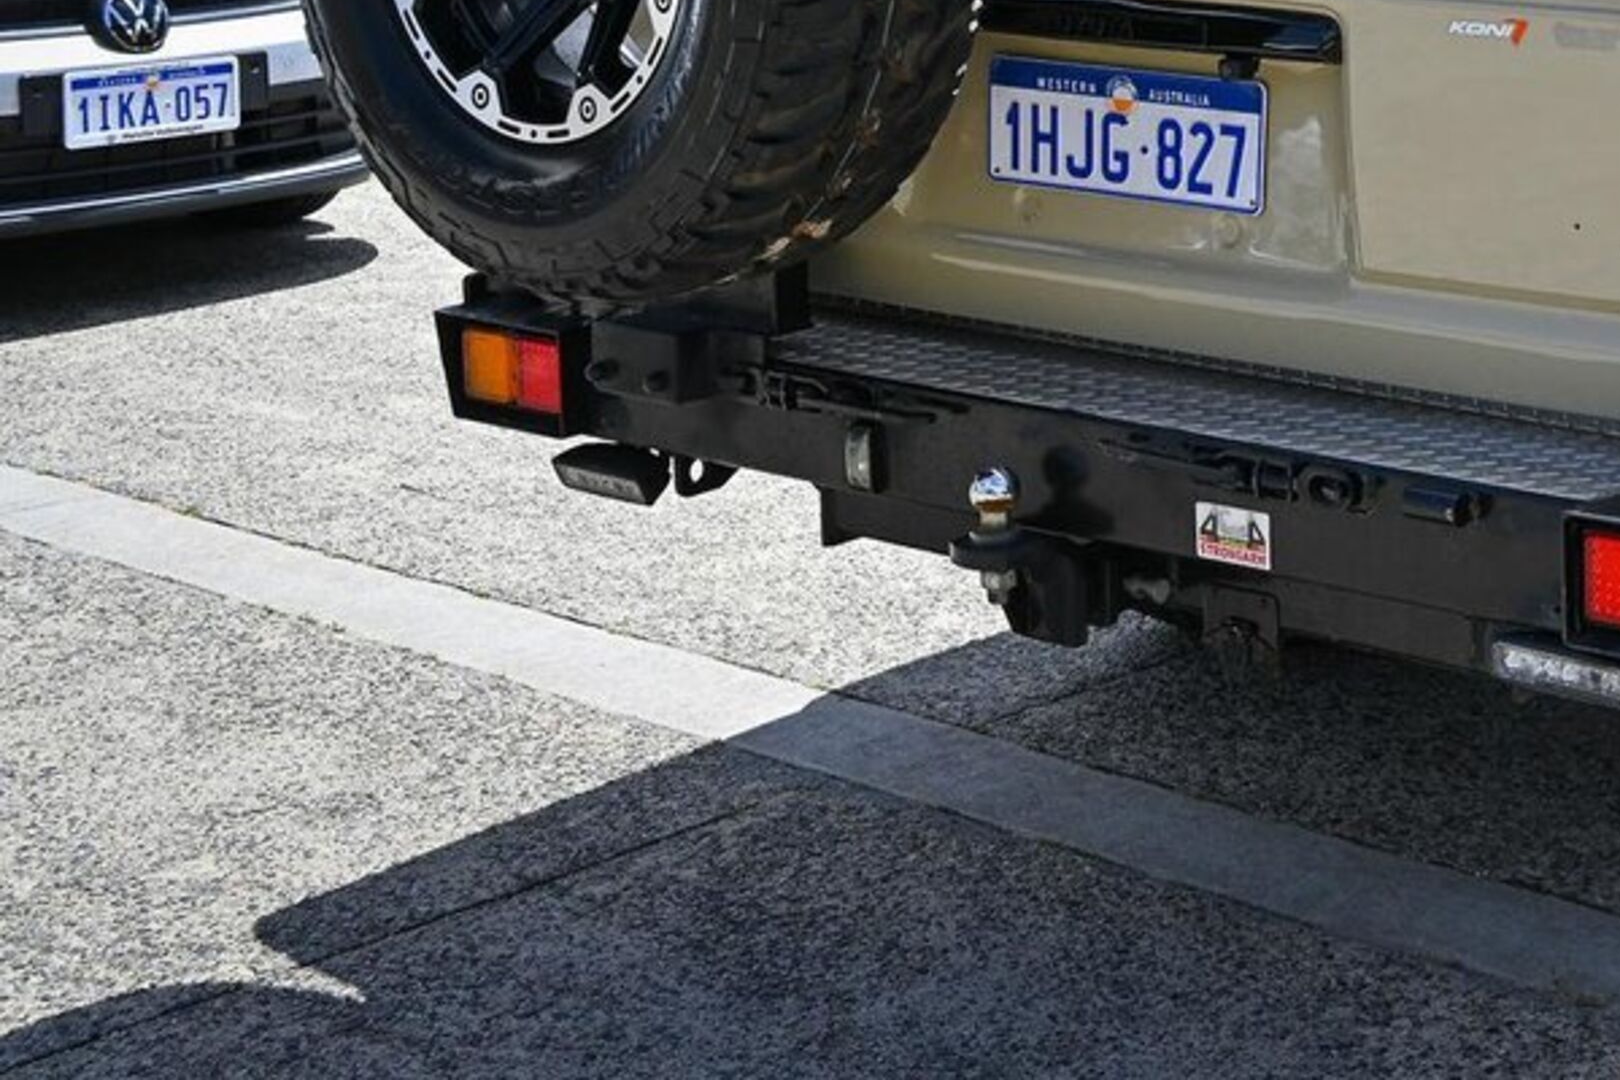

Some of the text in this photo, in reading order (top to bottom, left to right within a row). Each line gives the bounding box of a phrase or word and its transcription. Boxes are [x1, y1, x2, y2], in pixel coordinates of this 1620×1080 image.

[1449, 19, 1515, 38] KONI
[1036, 76, 1211, 107] WESTERN AUSTRALIA
